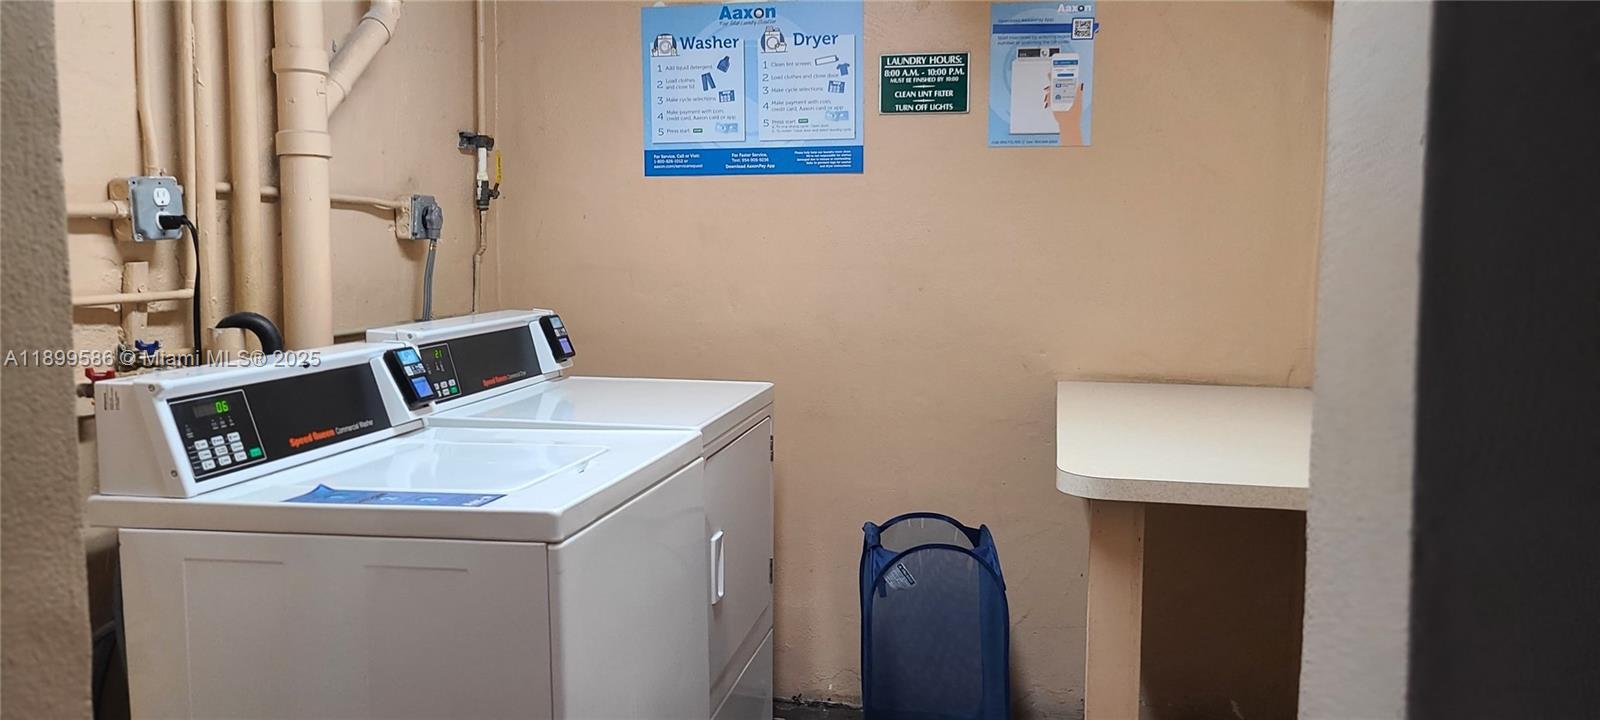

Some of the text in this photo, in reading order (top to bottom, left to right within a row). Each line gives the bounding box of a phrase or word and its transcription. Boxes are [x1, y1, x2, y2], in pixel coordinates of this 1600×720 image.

[719, 6, 776, 20] Aaxon
[1058, 4, 1092, 12] Aaxon
[680, 36, 739, 50] Washer
[793, 33, 838, 49] Dryer
[763, 61, 767, 69] 1
[887, 55, 962, 65] LAUNDRY HOURS:
[657, 80, 663, 89] 2
[658, 128, 664, 136] 5
[215, 400, 229, 413] 06
[289, 433, 313, 448] Speed
[312, 428, 336, 441] Queen
